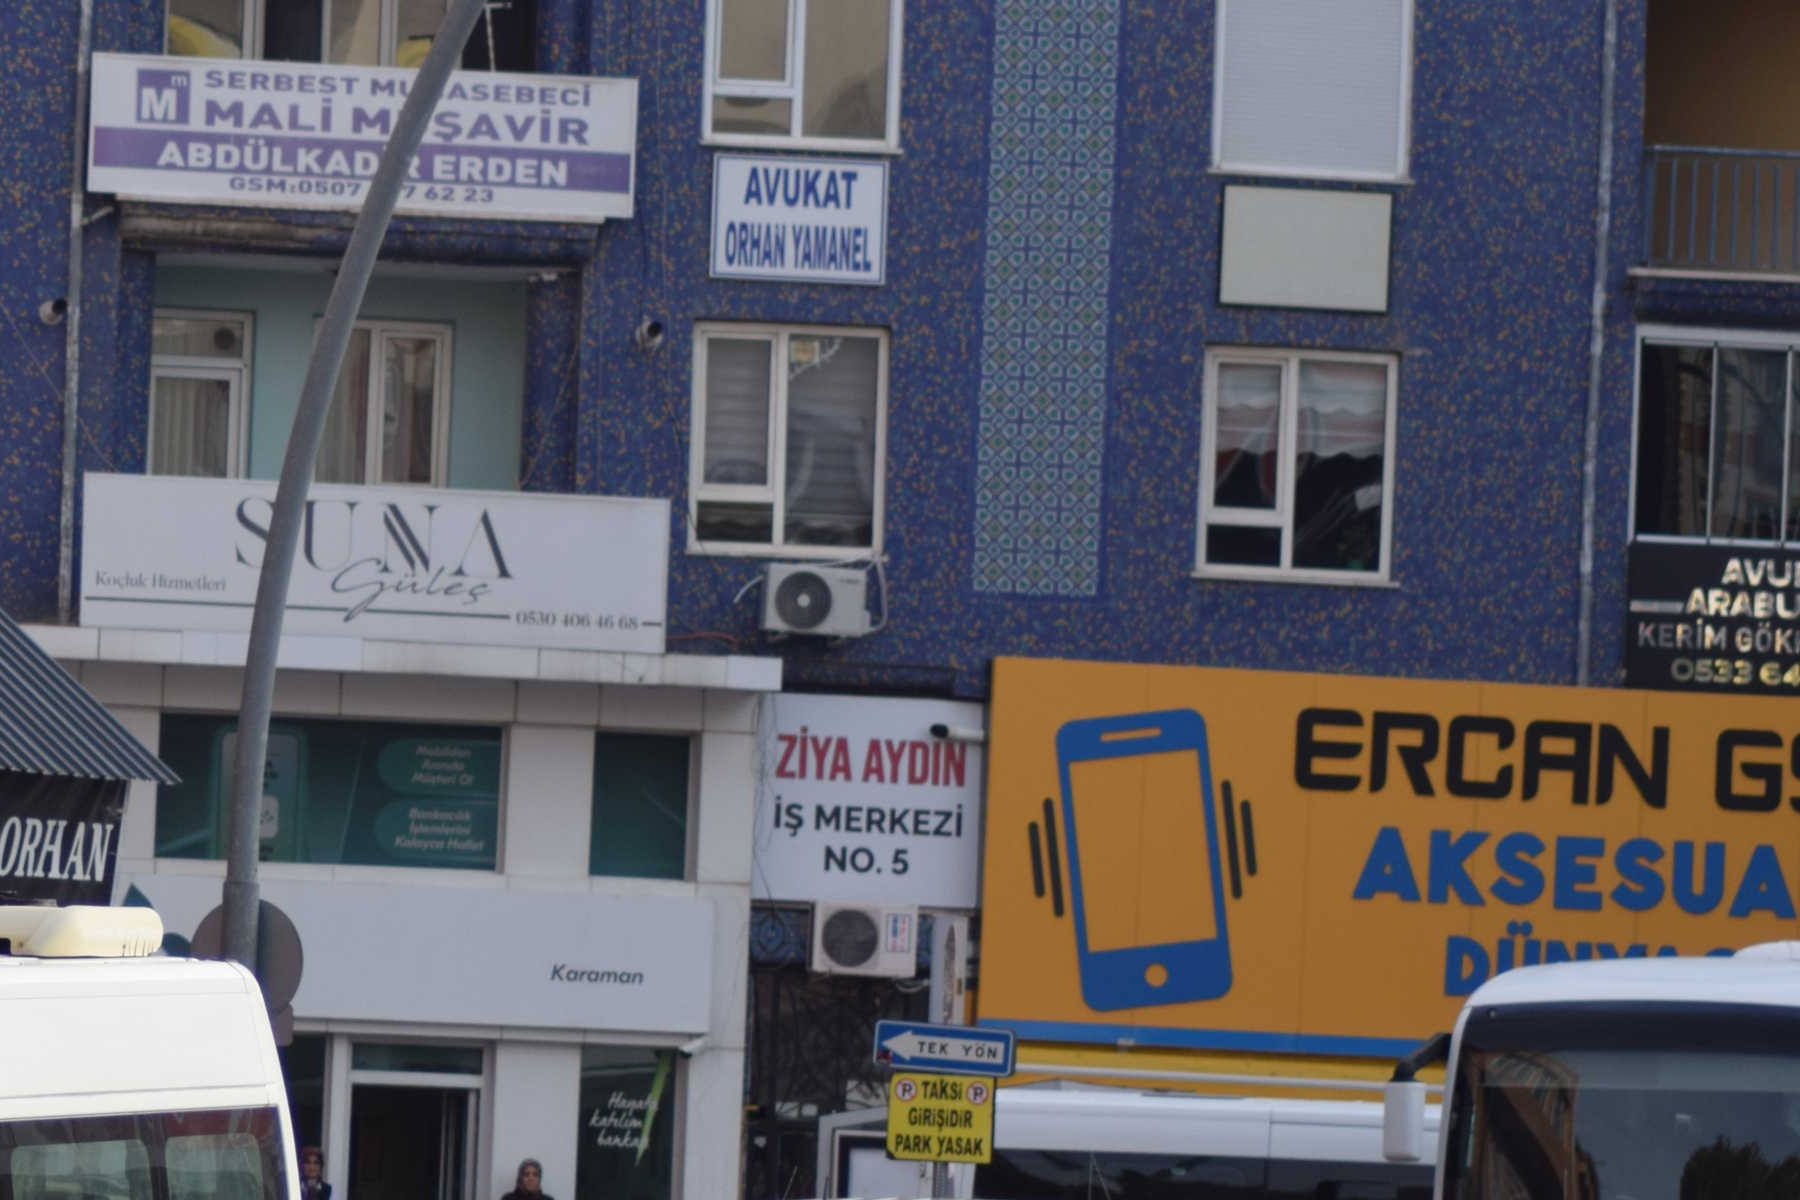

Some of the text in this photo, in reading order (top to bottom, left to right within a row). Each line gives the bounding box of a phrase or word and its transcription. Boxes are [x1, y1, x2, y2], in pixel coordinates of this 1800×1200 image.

[205, 70, 591, 107] SERBEST MASEBECİ
[205, 97, 589, 145] MALİ MŞAVİR
[433, 154, 568, 187] ERDEN
[744, 166, 858, 210] AVUKAT
[424, 186, 457, 201] 62
[463, 187, 495, 202] 23
[725, 220, 872, 273] ORHAN YAMANEL
[1721, 557, 1800, 588] AVU
[1637, 617, 1800, 654] KERİM GÖK
[1670, 656, 1753, 685] 0533
[775, 726, 967, 788] ZİYA AYDIN
[1294, 707, 1800, 813] ERCAN G
[773, 795, 964, 838] İŞ MERKEZİ
[823, 845, 910, 875] NO. 5
[1351, 826, 1798, 919] AKSESUA
[550, 963, 645, 985] Karaman
[917, 1040, 998, 1059] TEK YÖN
[894, 1133, 984, 1158] PARK YASAK
